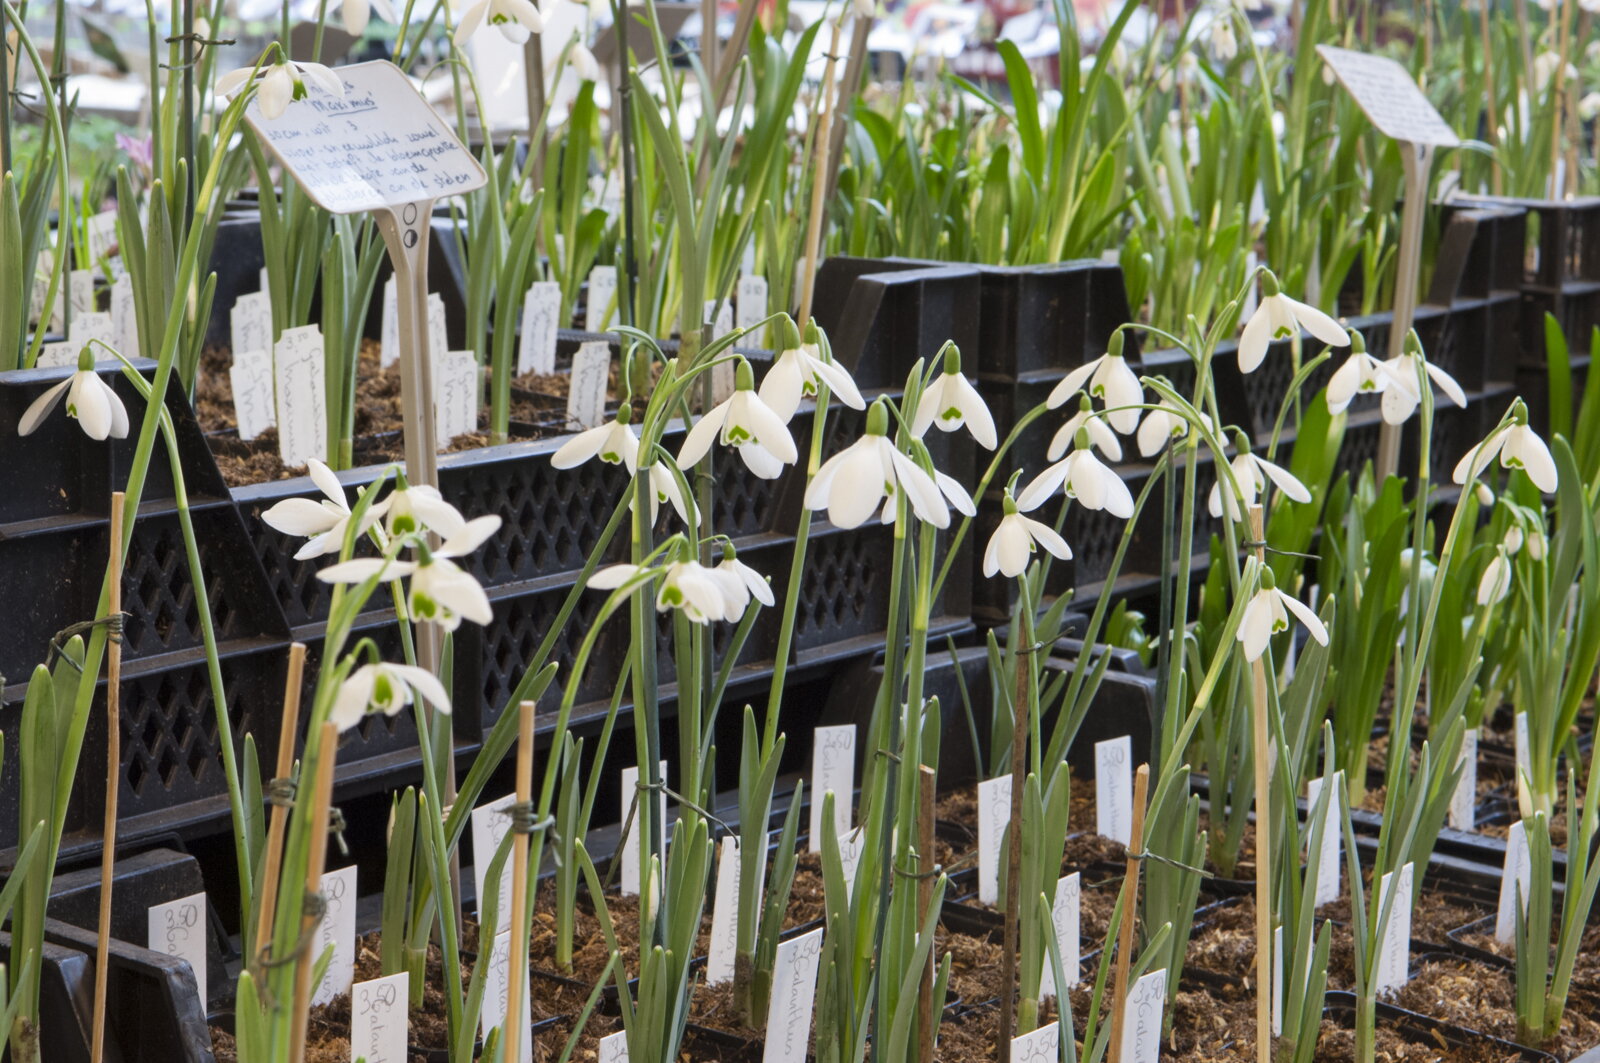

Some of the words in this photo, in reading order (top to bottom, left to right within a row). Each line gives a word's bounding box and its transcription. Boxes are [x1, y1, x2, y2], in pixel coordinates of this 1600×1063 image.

[410, 161, 428, 174] de
[388, 182, 409, 193] en
[410, 176, 429, 189] de
[165, 903, 198, 929] 3.50
[784, 956, 810, 1056] Galanthus
